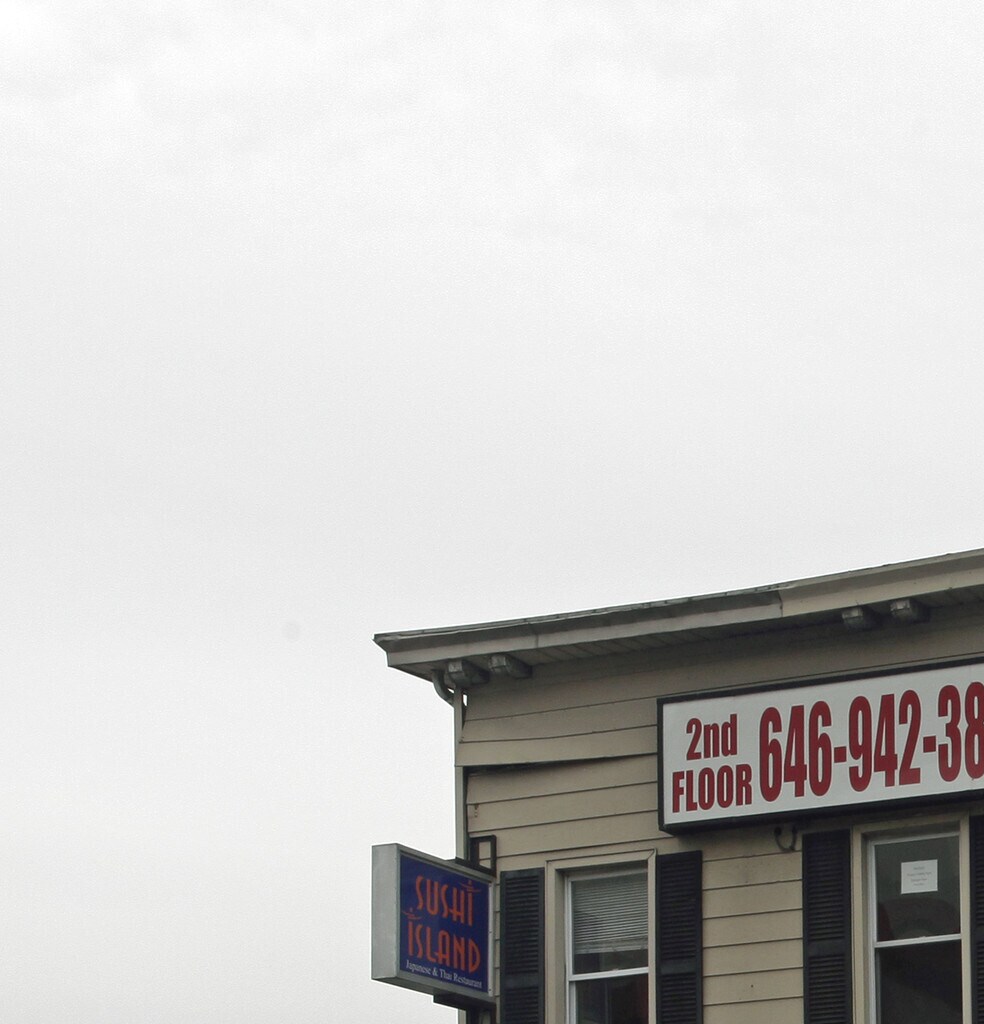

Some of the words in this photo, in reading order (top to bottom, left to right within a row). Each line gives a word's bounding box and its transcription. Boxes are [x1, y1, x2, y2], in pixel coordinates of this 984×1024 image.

[685, 713, 739, 761] 2nd
[671, 763, 753, 813] FLOOR
[416, 875, 474, 926] SUSHI
[407, 920, 481, 973] ISLAND
[406, 960, 431, 974] Japanese
[453, 973, 482, 988] Restaurant
